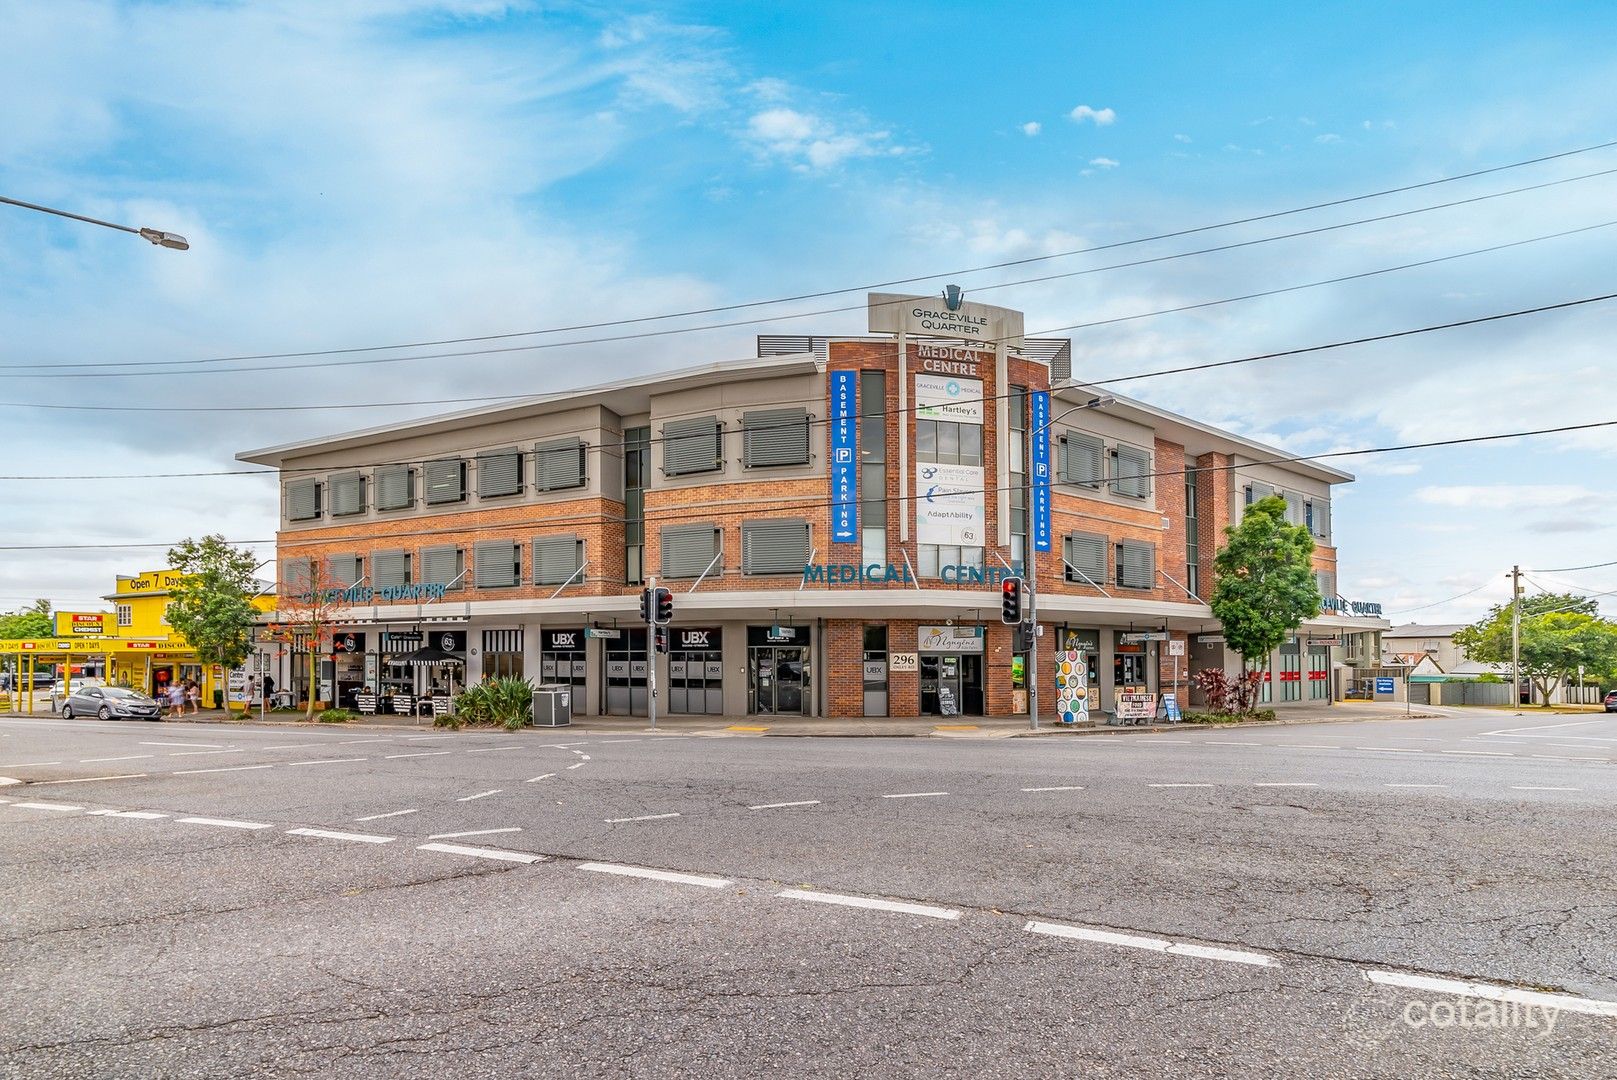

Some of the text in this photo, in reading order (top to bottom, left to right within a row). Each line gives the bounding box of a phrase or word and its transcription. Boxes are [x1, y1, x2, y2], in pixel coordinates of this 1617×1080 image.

[912, 308, 988, 326] GRACEVILLE
[922, 320, 980, 334] QUARTER
[918, 345, 980, 362] MEDICAL
[923, 360, 976, 375] CENTRE
[942, 405, 976, 415] Hartley's
[928, 511, 973, 520] AdaptAbility
[964, 532, 974, 540] 63
[804, 564, 912, 584] MEDICAL
[130, 579, 150, 590] Open
[153, 574, 159, 587] 7
[381, 582, 446, 600] QUARTER
[552, 633, 574, 644] UBX
[682, 631, 708, 643] UBX
[893, 655, 914, 664] 296
